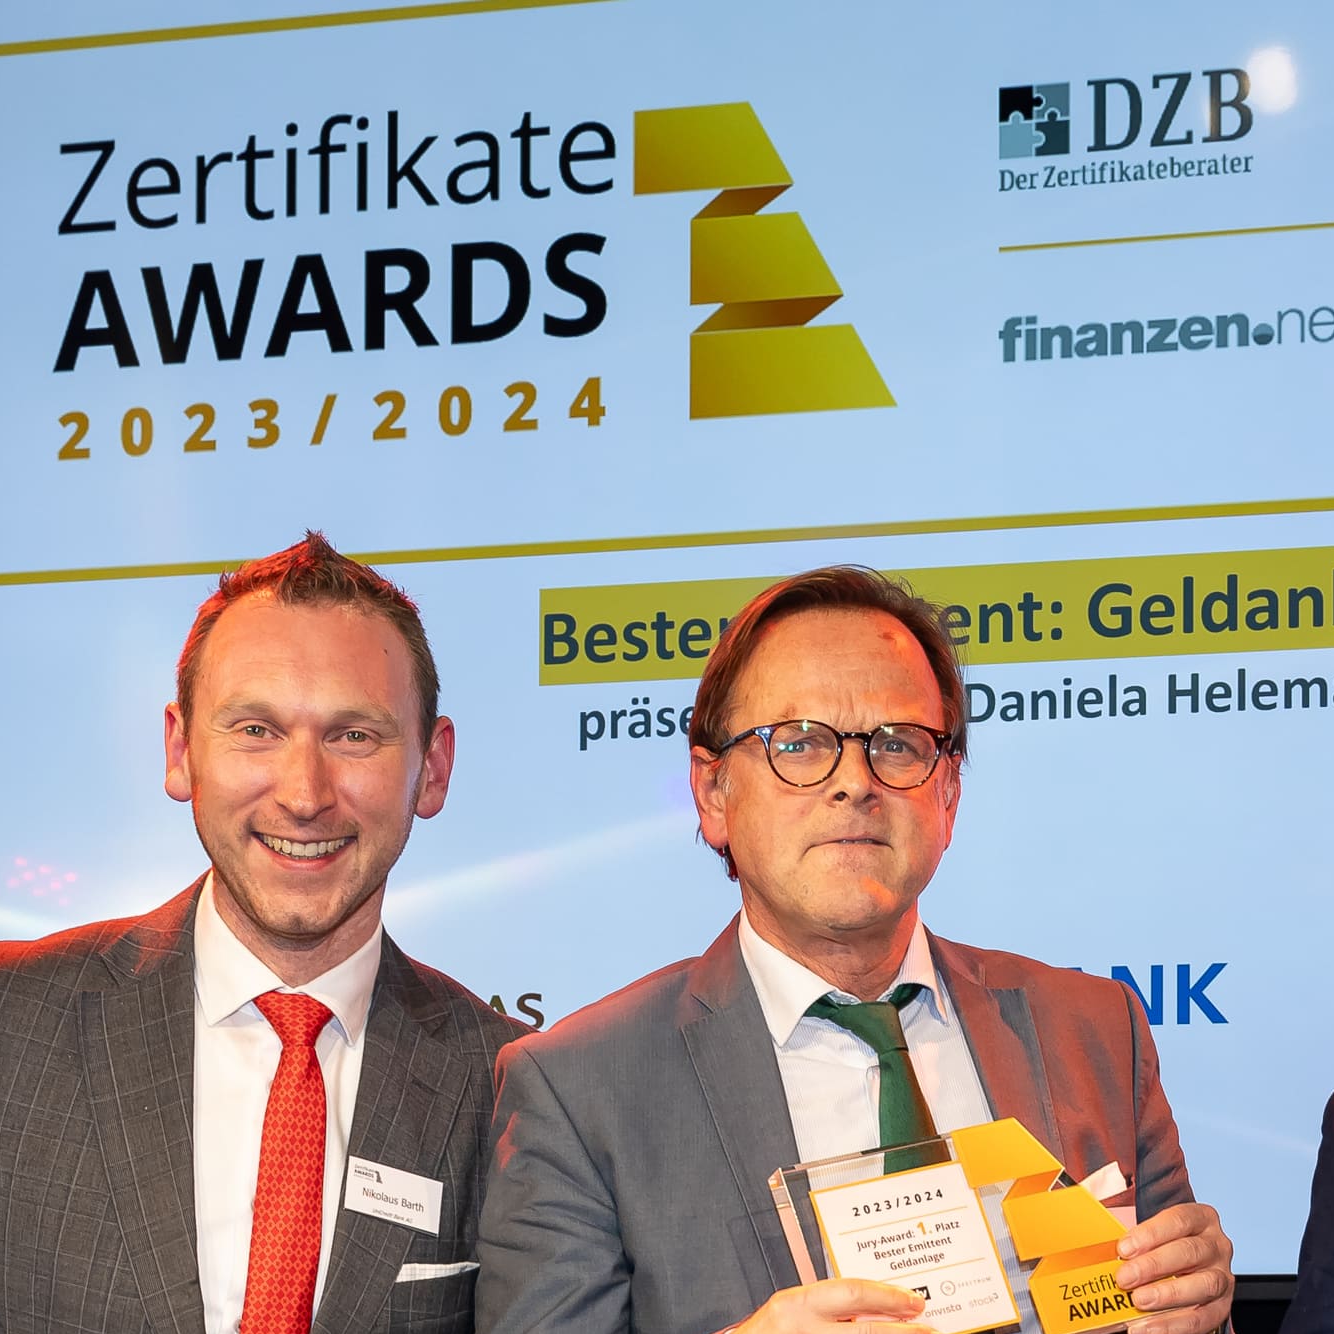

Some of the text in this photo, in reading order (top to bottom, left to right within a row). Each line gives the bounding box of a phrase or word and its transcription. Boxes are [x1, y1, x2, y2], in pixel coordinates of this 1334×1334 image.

[1087, 68, 1254, 152] DZB
[57, 110, 616, 237] Zertifikate
[998, 154, 1254, 192] Der Zertifikateberater
[53, 232, 609, 373] AWARDS
[56, 376, 607, 461] 2023/2024
[964, 673, 1147, 724] Daniela
[362, 1187, 425, 1213] Nikolaus Barth
[852, 1188, 944, 1217] 2023/2024
[856, 1229, 916, 1252] Jury-Award:
[935, 1220, 961, 1233] Platz
[873, 1236, 952, 1261] Bester Emittent
[889, 1251, 946, 1271] Geldanlage
[1059, 1272, 1118, 1301] Zertifik
[1068, 1290, 1135, 1322] AWAR
